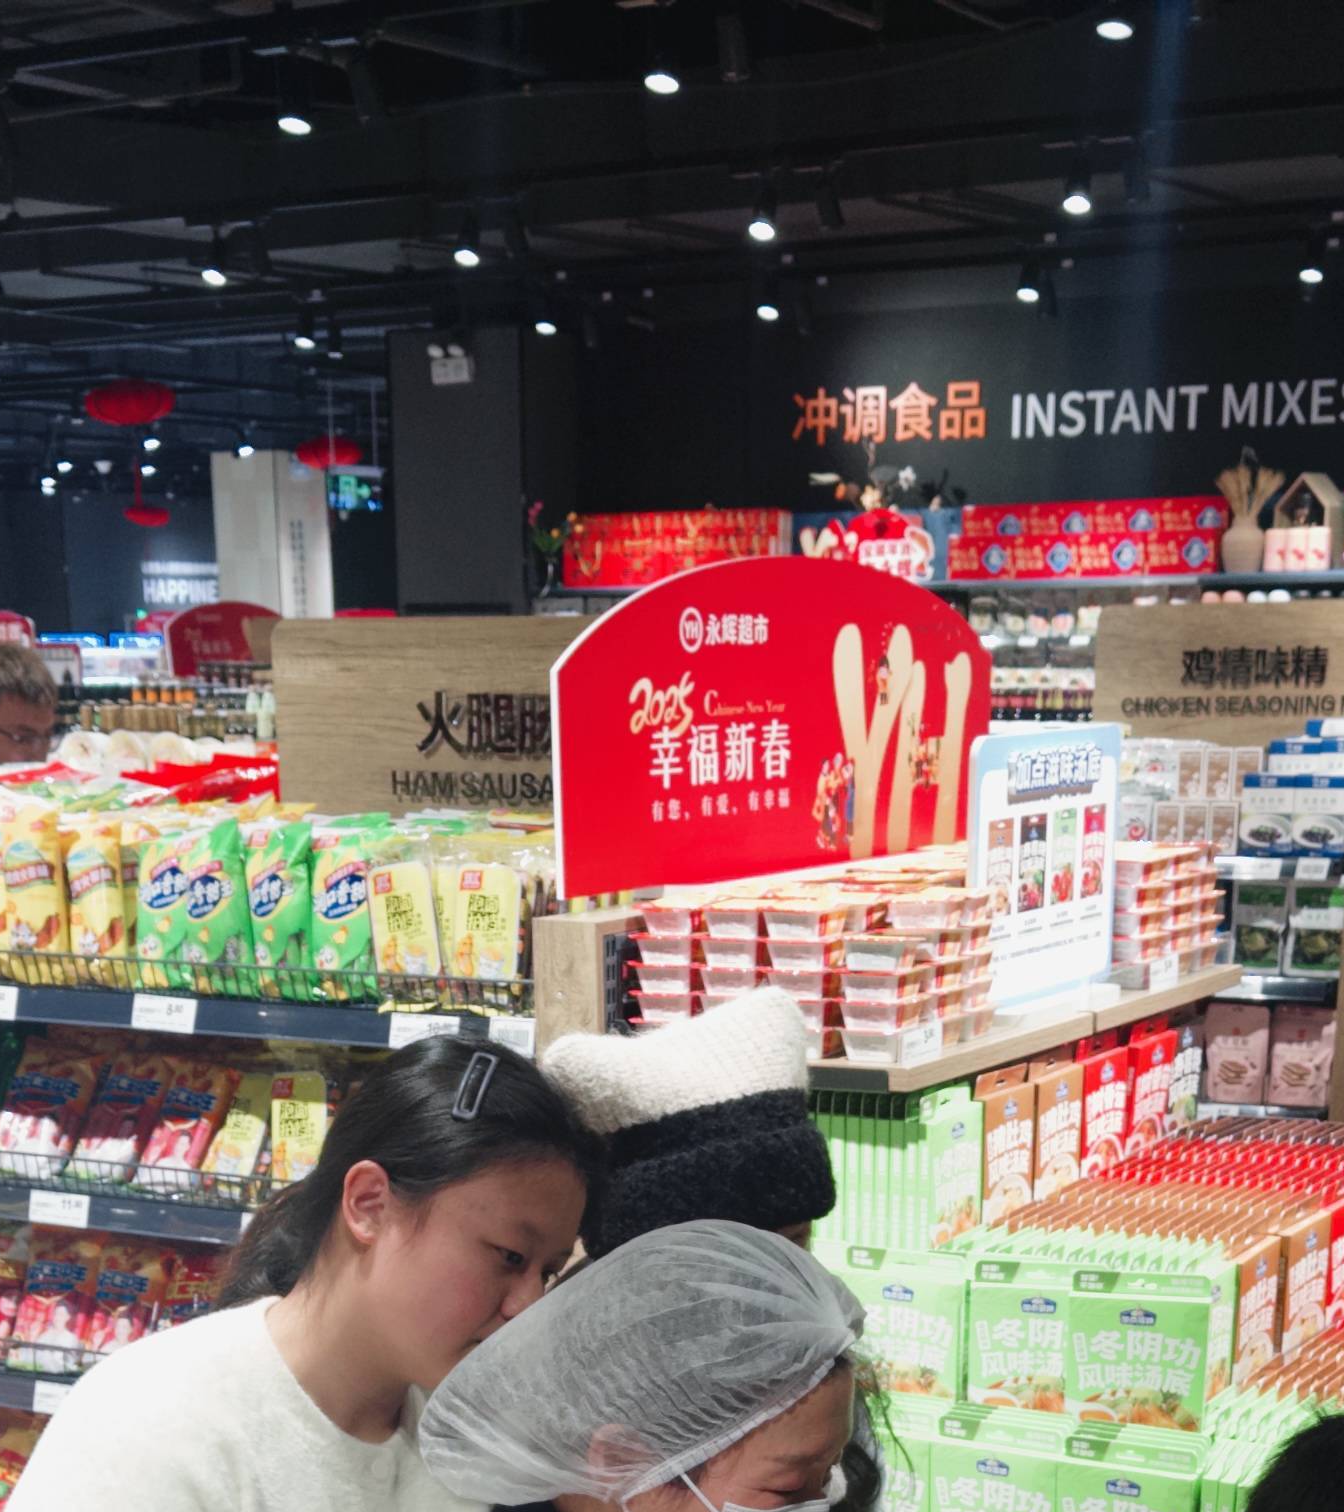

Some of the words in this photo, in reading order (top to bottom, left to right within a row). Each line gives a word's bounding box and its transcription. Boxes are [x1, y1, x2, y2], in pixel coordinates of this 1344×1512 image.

[793, 380, 987, 445] 冲调食品
[1011, 382, 1209, 439] INSTANT
[705, 614, 769, 646] 永辉超市
[1181, 645, 1328, 689] 鸡精味精
[416, 690, 551, 759] 火腿肠
[628, 672, 696, 737] 2025
[1122, 695, 1211, 718] CHICKEN
[1215, 694, 1336, 717] SEASONING
[649, 719, 791, 790] 幸福新春
[392, 771, 454, 803] HAM
[1091, 1329, 1202, 1370] 冬阴功
[1078, 1363, 1196, 1396] 风味汤底
